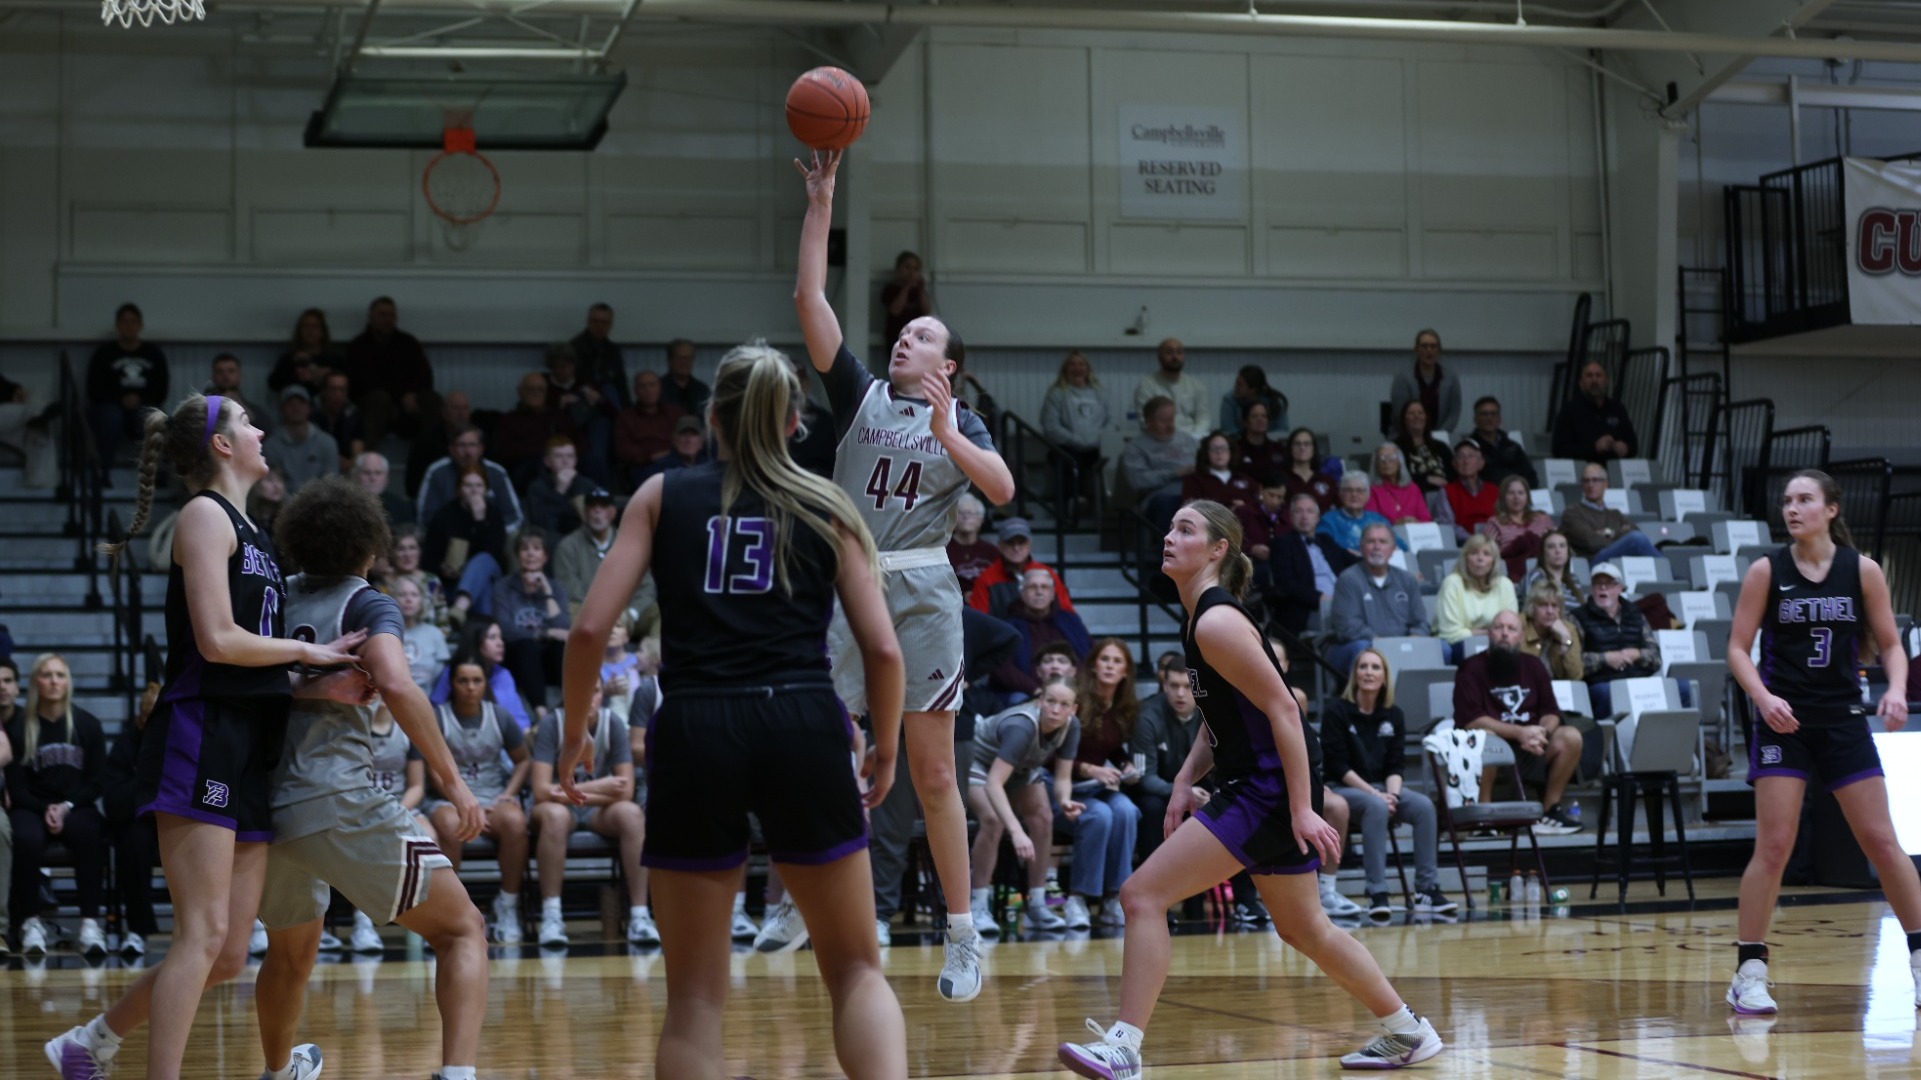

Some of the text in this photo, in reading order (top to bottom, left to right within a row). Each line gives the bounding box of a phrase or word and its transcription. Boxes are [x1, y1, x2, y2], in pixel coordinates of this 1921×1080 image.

[1138, 160, 1222, 176] RESERVED
[1144, 179, 1216, 194] SEATING
[865, 454, 924, 512] 44
[704, 515, 779, 594] 13
[1779, 597, 1856, 623] BETHEL
[1807, 627, 1833, 667] 3
